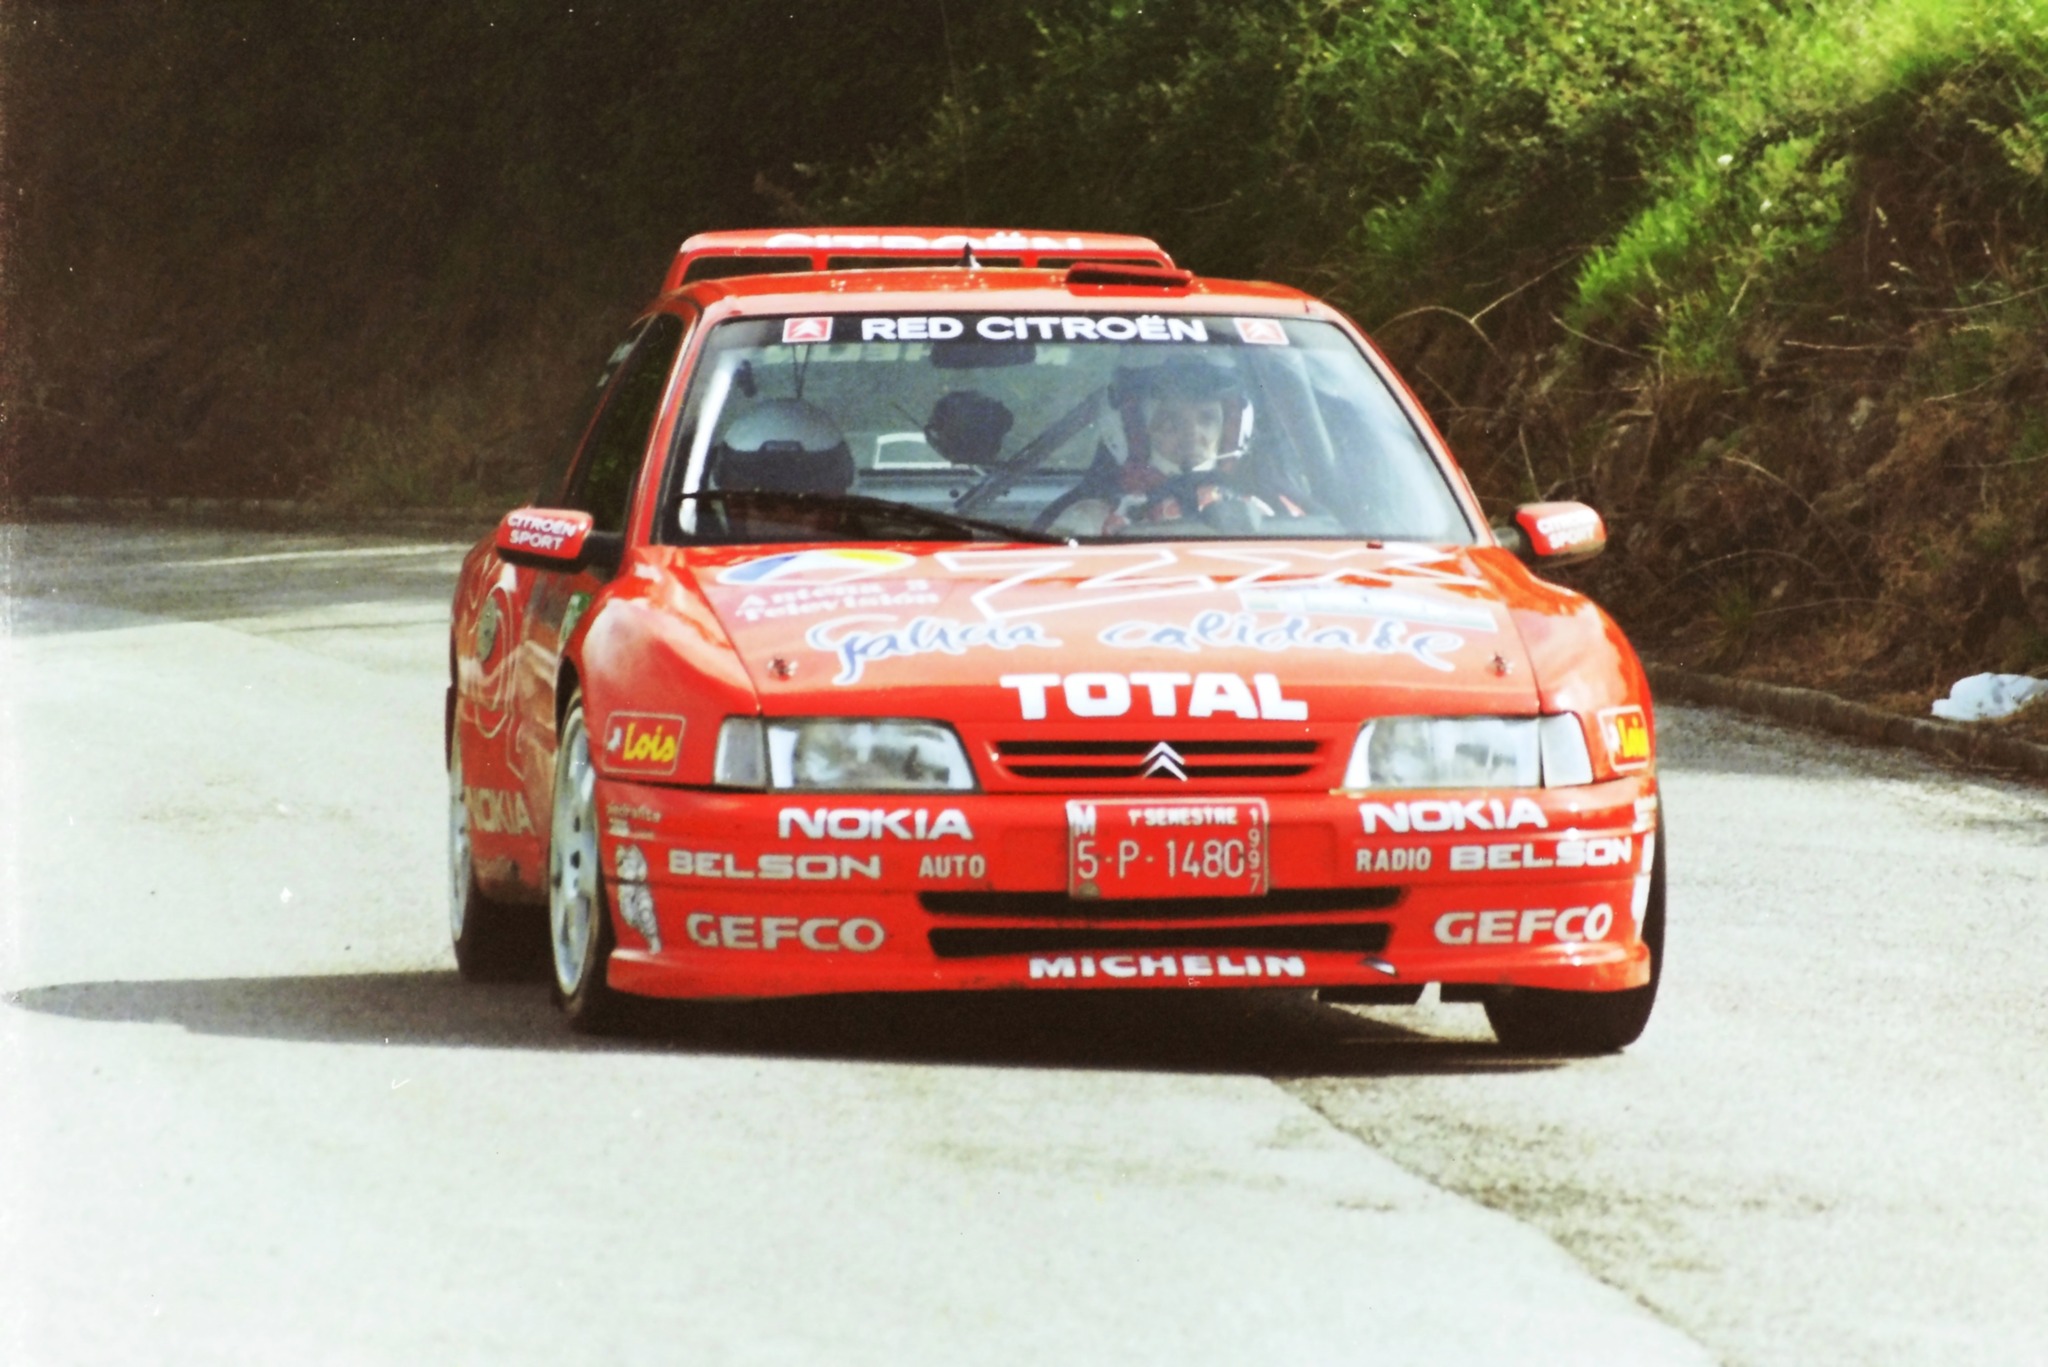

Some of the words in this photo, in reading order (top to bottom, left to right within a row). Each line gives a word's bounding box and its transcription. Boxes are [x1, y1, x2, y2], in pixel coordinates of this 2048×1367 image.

[861, 316, 965, 341] RED
[976, 314, 1208, 343] CITROËN
[510, 529, 564, 551] SPORT
[806, 614, 1064, 686] Galicia
[1000, 672, 1309, 722] TOTAL
[622, 722, 677, 763] Lois
[778, 807, 974, 841] NOKIA
[1066, 801, 1097, 836] M
[1143, 806, 1238, 826] SEMESTRE
[1358, 798, 1549, 835] NOKIA
[668, 848, 882, 880] BELSON
[918, 855, 986, 879] AUTO
[1355, 847, 1432, 872] RADIO
[1449, 836, 1633, 872] BELSON
[686, 912, 886, 953] GEFCO
[1433, 903, 1614, 945] GEFCO
[1028, 955, 1306, 980] MICHELIN
